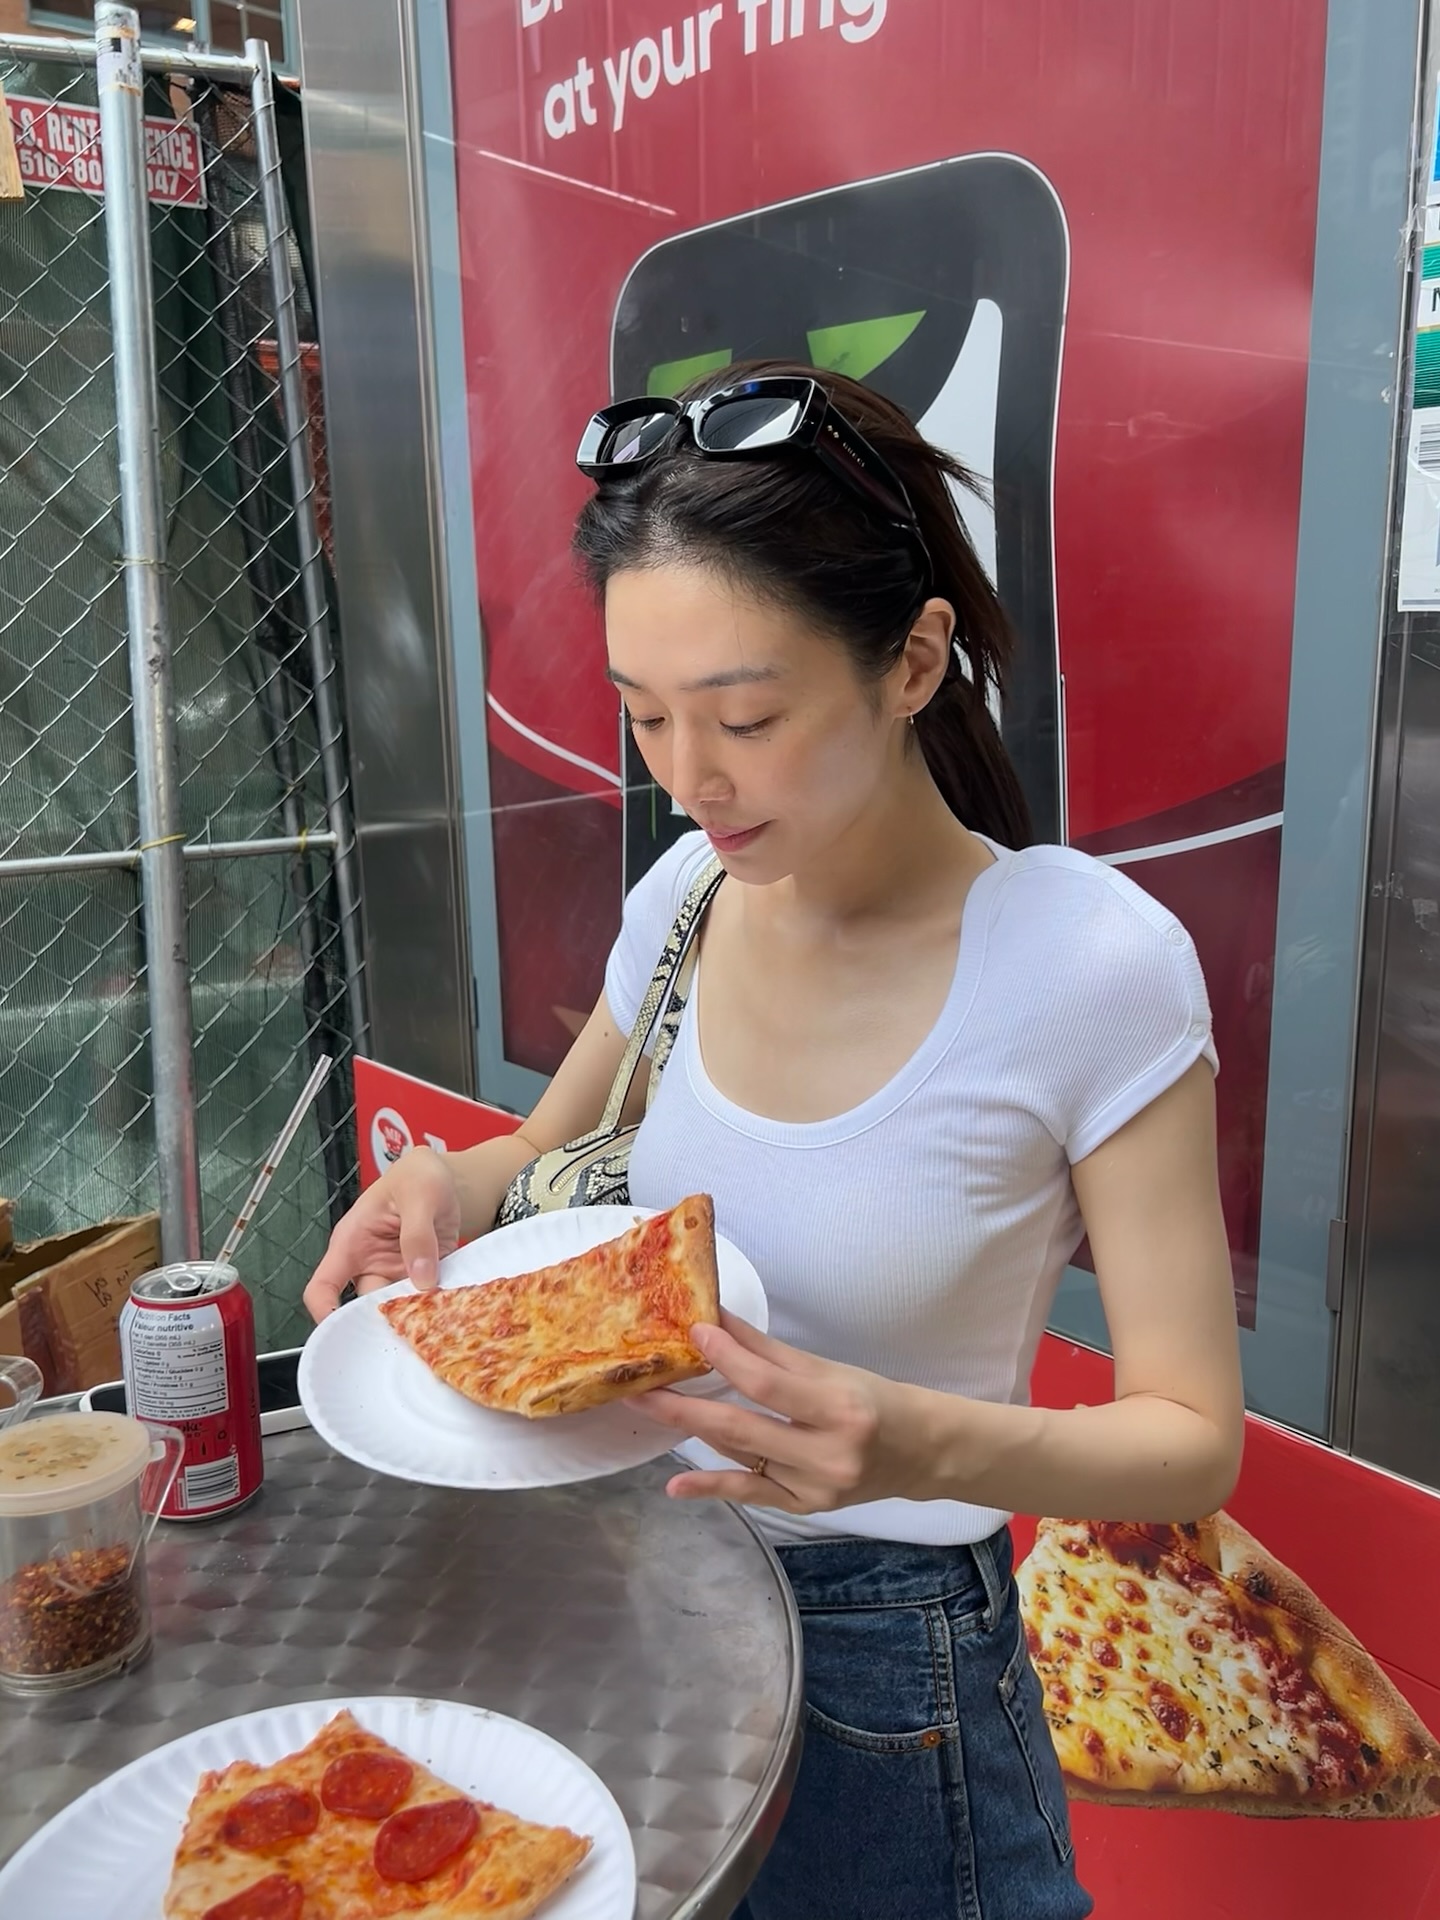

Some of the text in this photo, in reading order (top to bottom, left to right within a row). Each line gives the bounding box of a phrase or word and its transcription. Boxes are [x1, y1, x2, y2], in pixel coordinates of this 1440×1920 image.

[544, 57, 598, 140] at
[603, 3, 723, 133] your
[168, 1313, 191, 1321] Facts
[157, 1322, 194, 1332] nutritive
